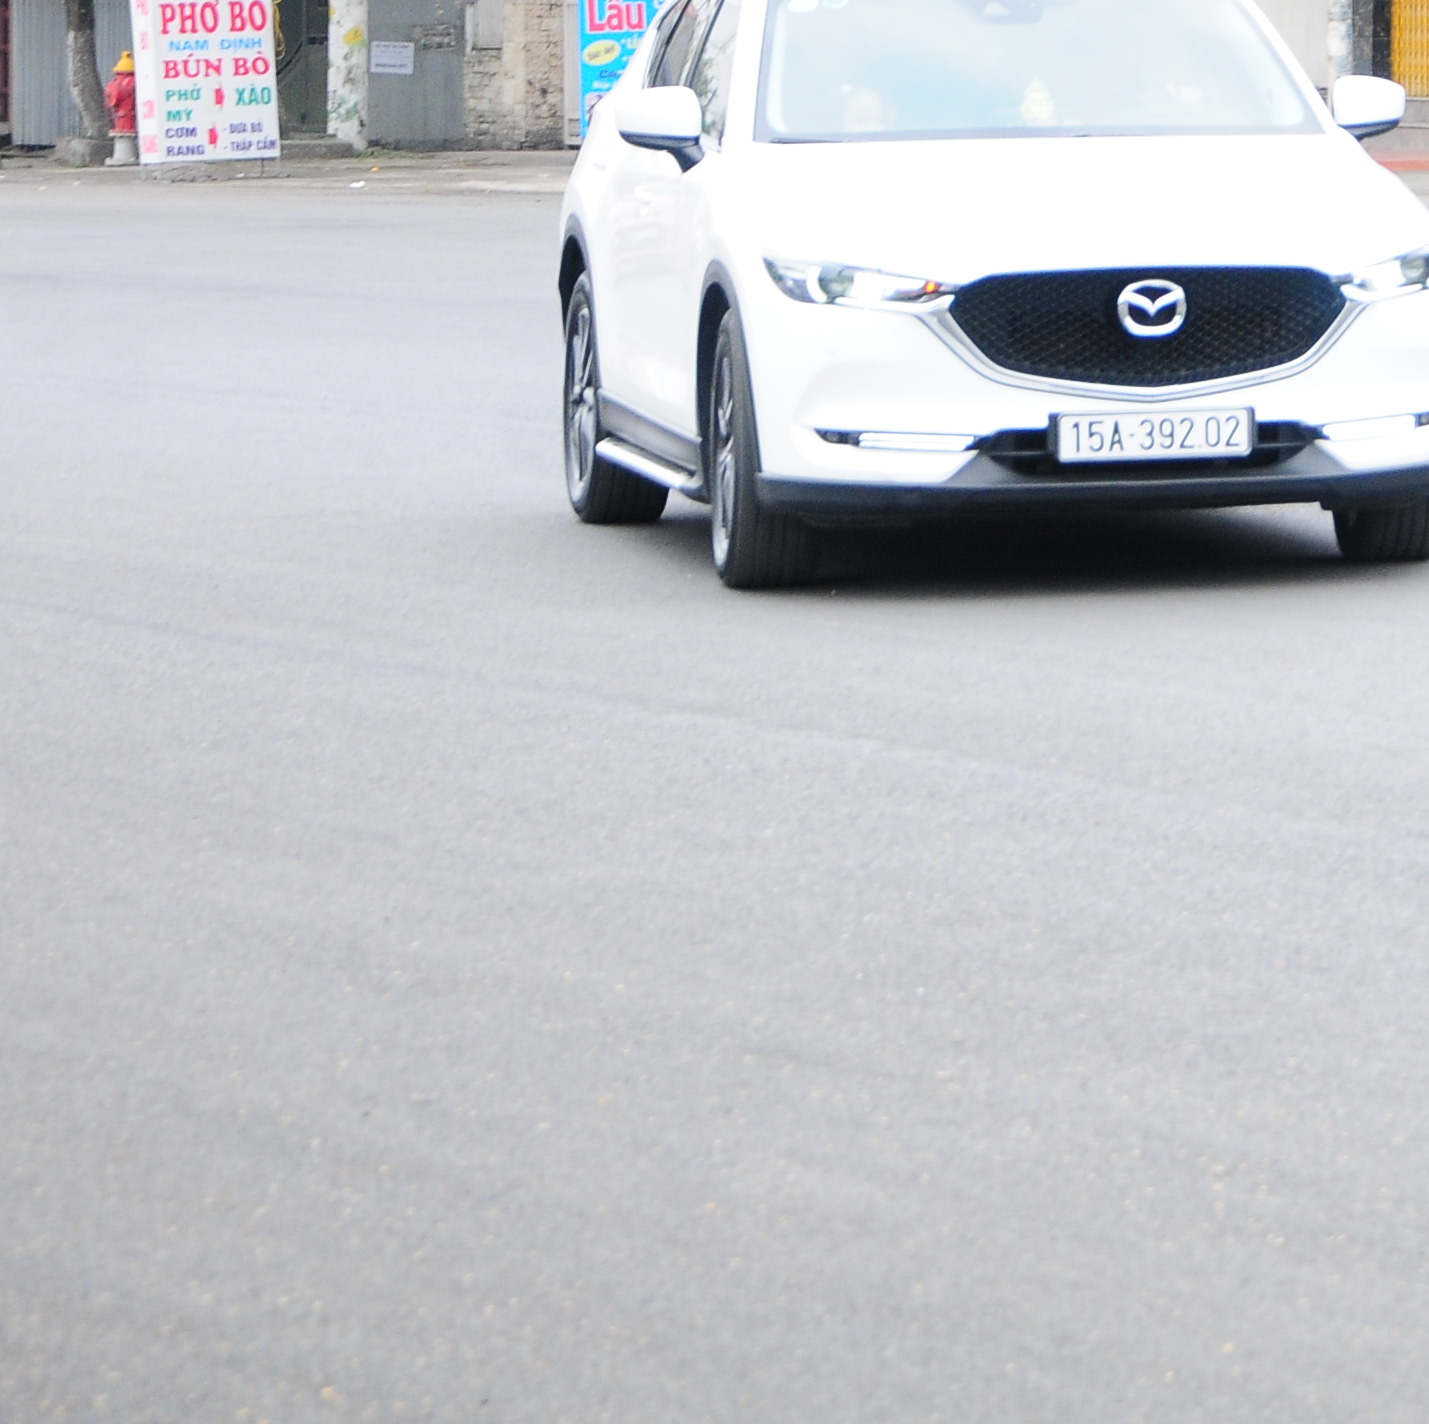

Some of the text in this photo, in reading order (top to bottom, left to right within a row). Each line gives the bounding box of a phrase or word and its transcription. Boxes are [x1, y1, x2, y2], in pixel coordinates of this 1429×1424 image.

[169, 39, 209, 51] NAM
[163, 51, 271, 79] BÚN BÒ
[165, 126, 198, 139] CƠM
[166, 144, 205, 157] RANG
[1072, 415, 1240, 453] 15A-392.02
